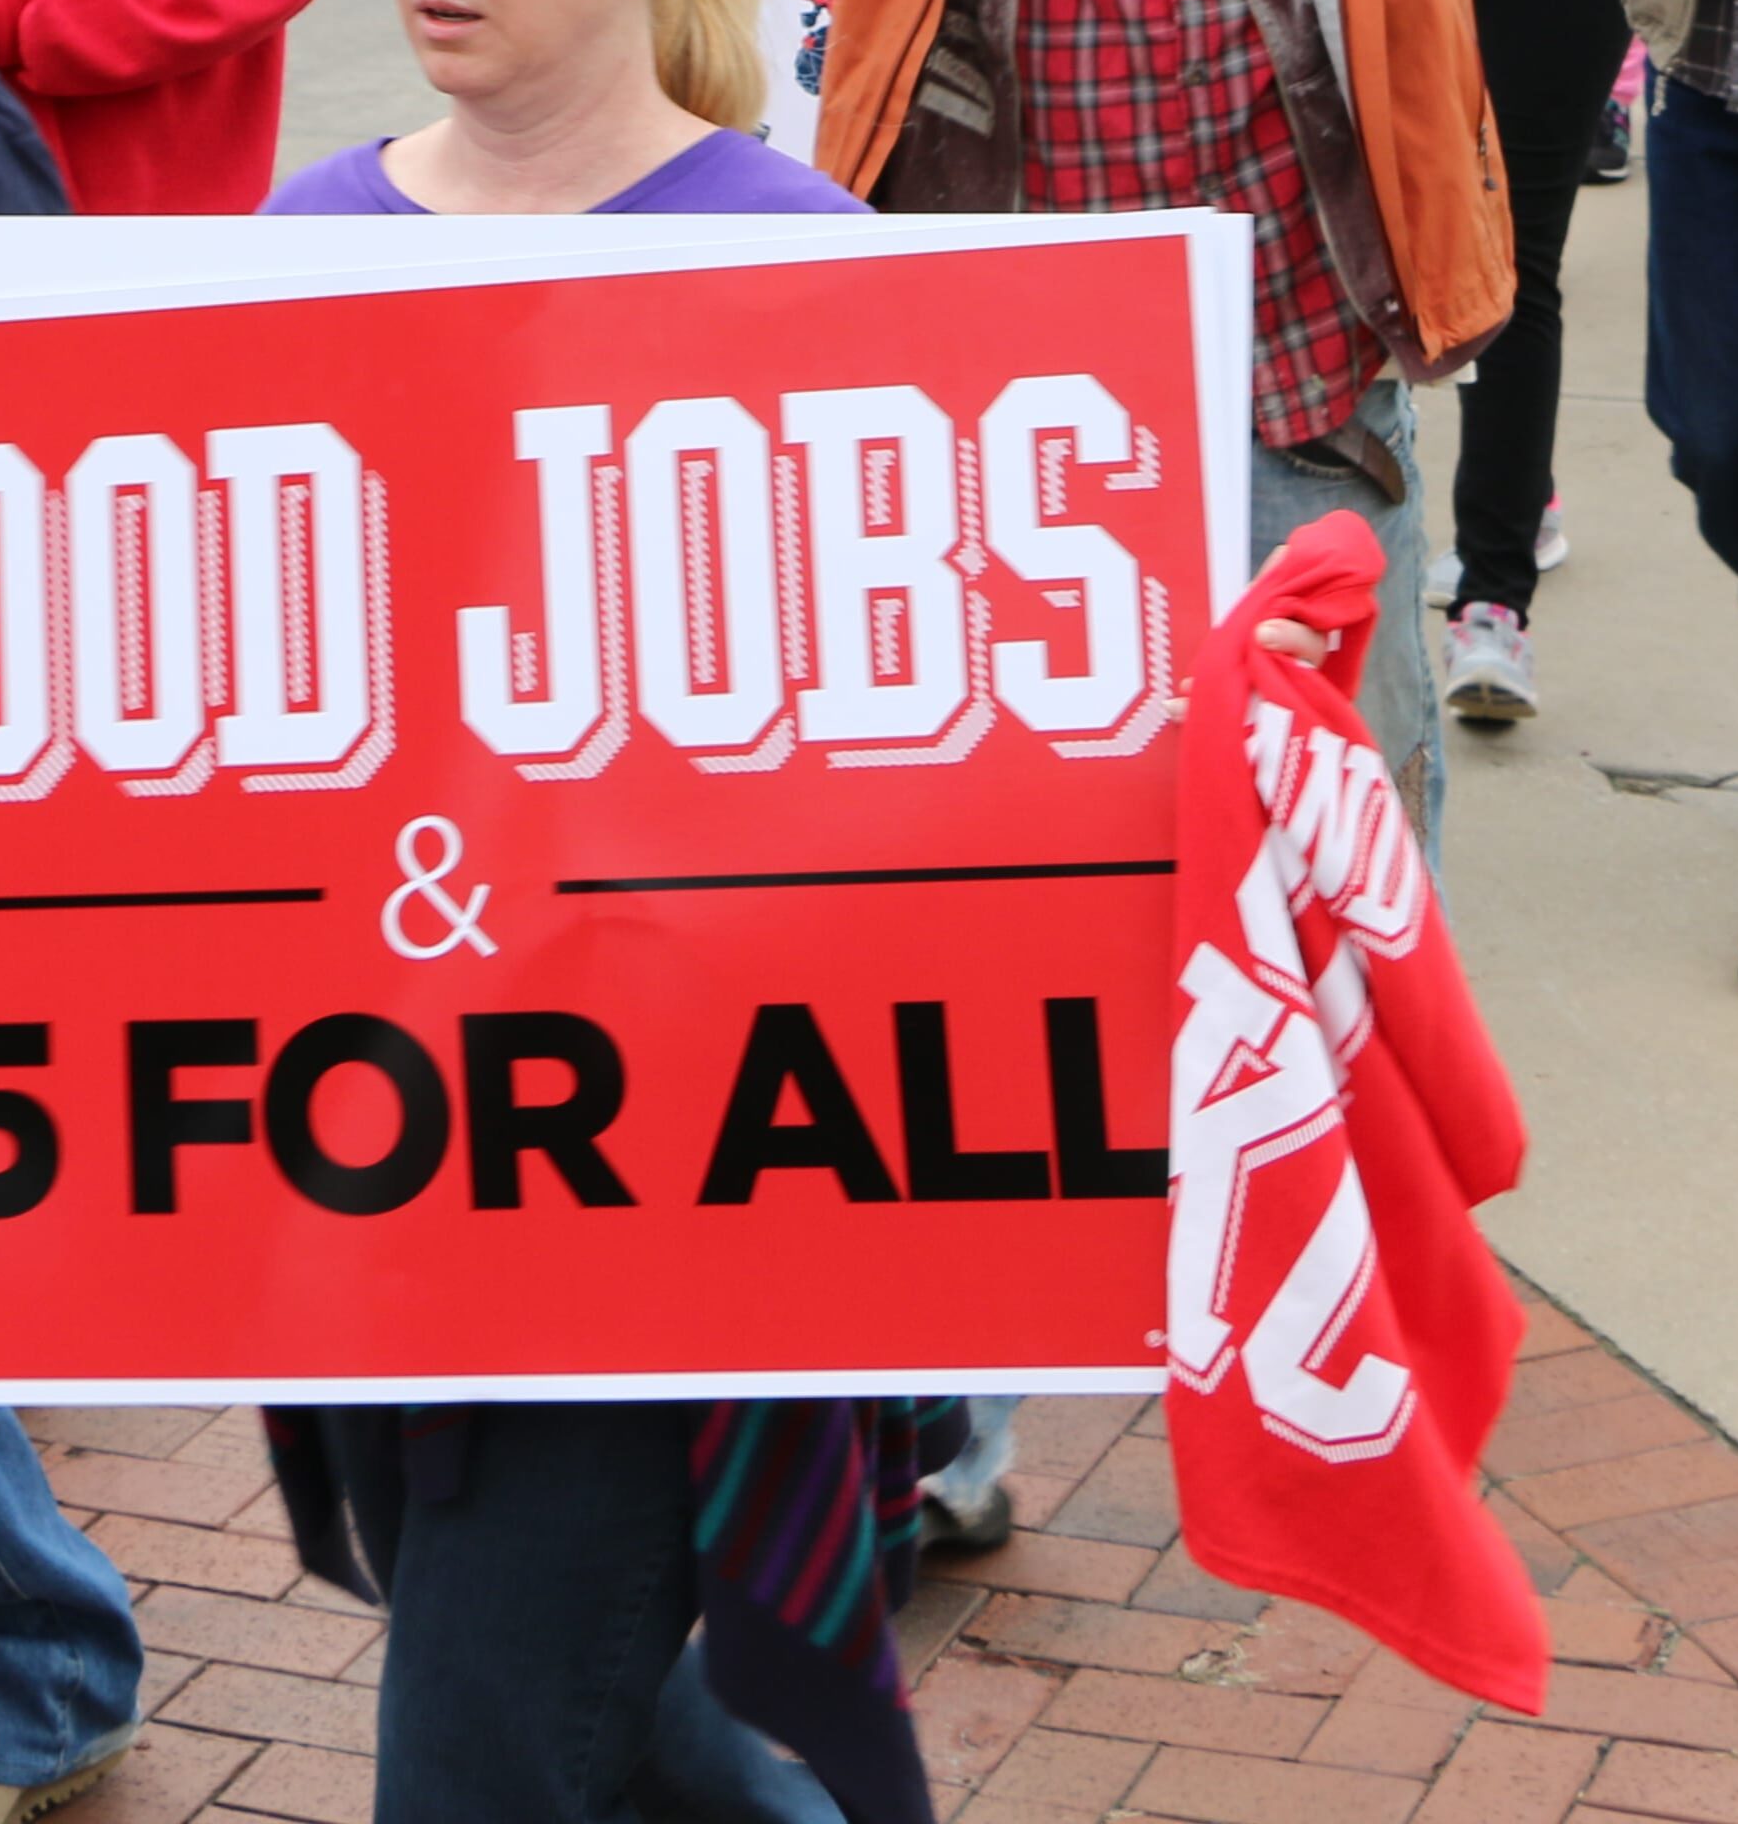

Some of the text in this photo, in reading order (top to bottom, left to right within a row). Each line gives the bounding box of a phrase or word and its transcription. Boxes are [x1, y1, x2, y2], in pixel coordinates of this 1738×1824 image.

[457, 373, 1168, 784] JOBS
[379, 815, 498, 962] &
[124, 1010, 639, 1217] FOR
[694, 997, 1173, 1207] ALL
